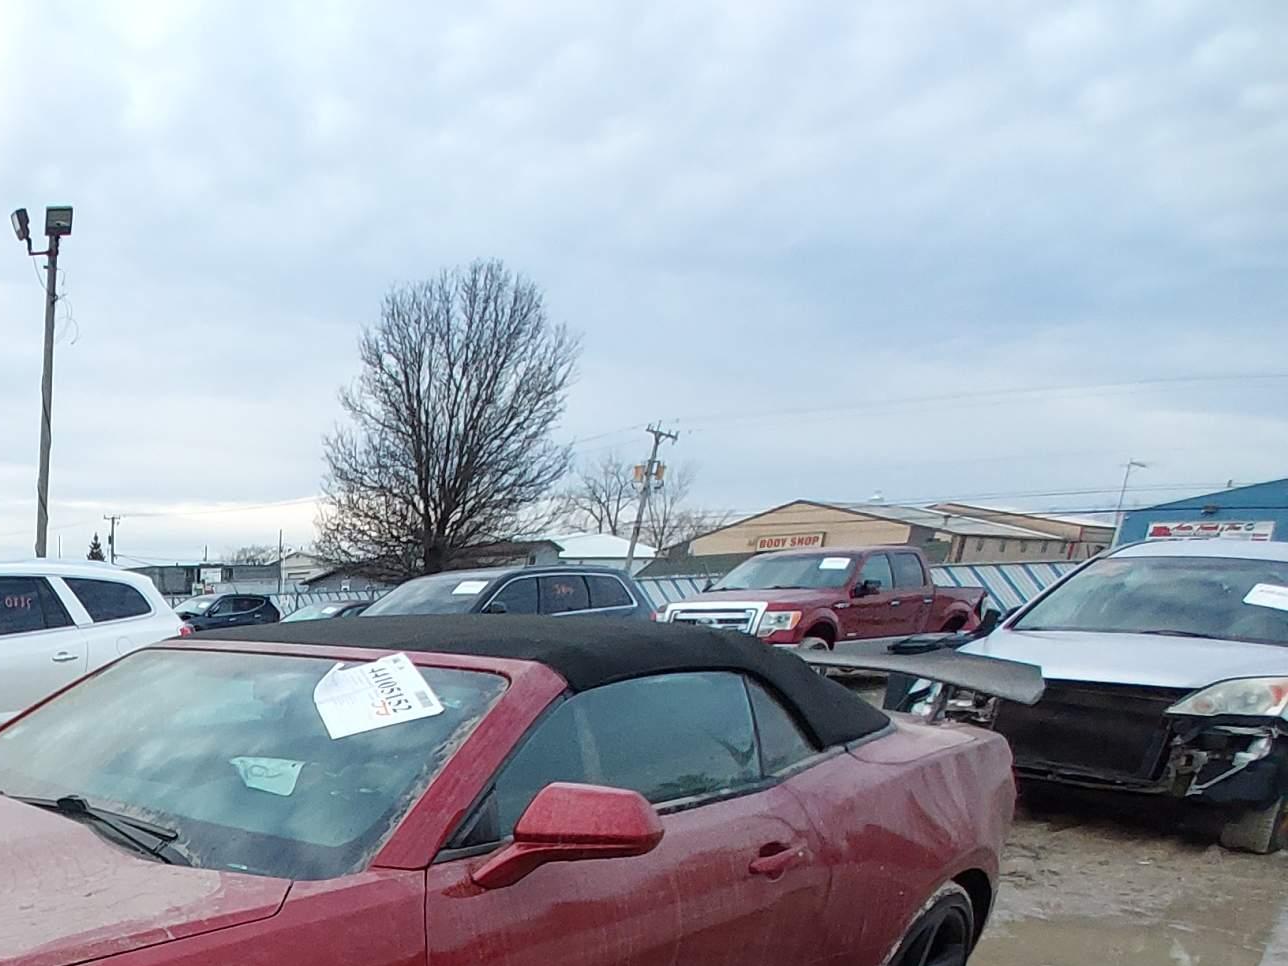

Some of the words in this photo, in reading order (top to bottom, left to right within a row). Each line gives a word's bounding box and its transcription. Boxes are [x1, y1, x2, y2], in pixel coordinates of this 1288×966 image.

[759, 538, 787, 549] BODY
[790, 536, 819, 547] SHOP
[369, 667, 412, 713] 44105152
